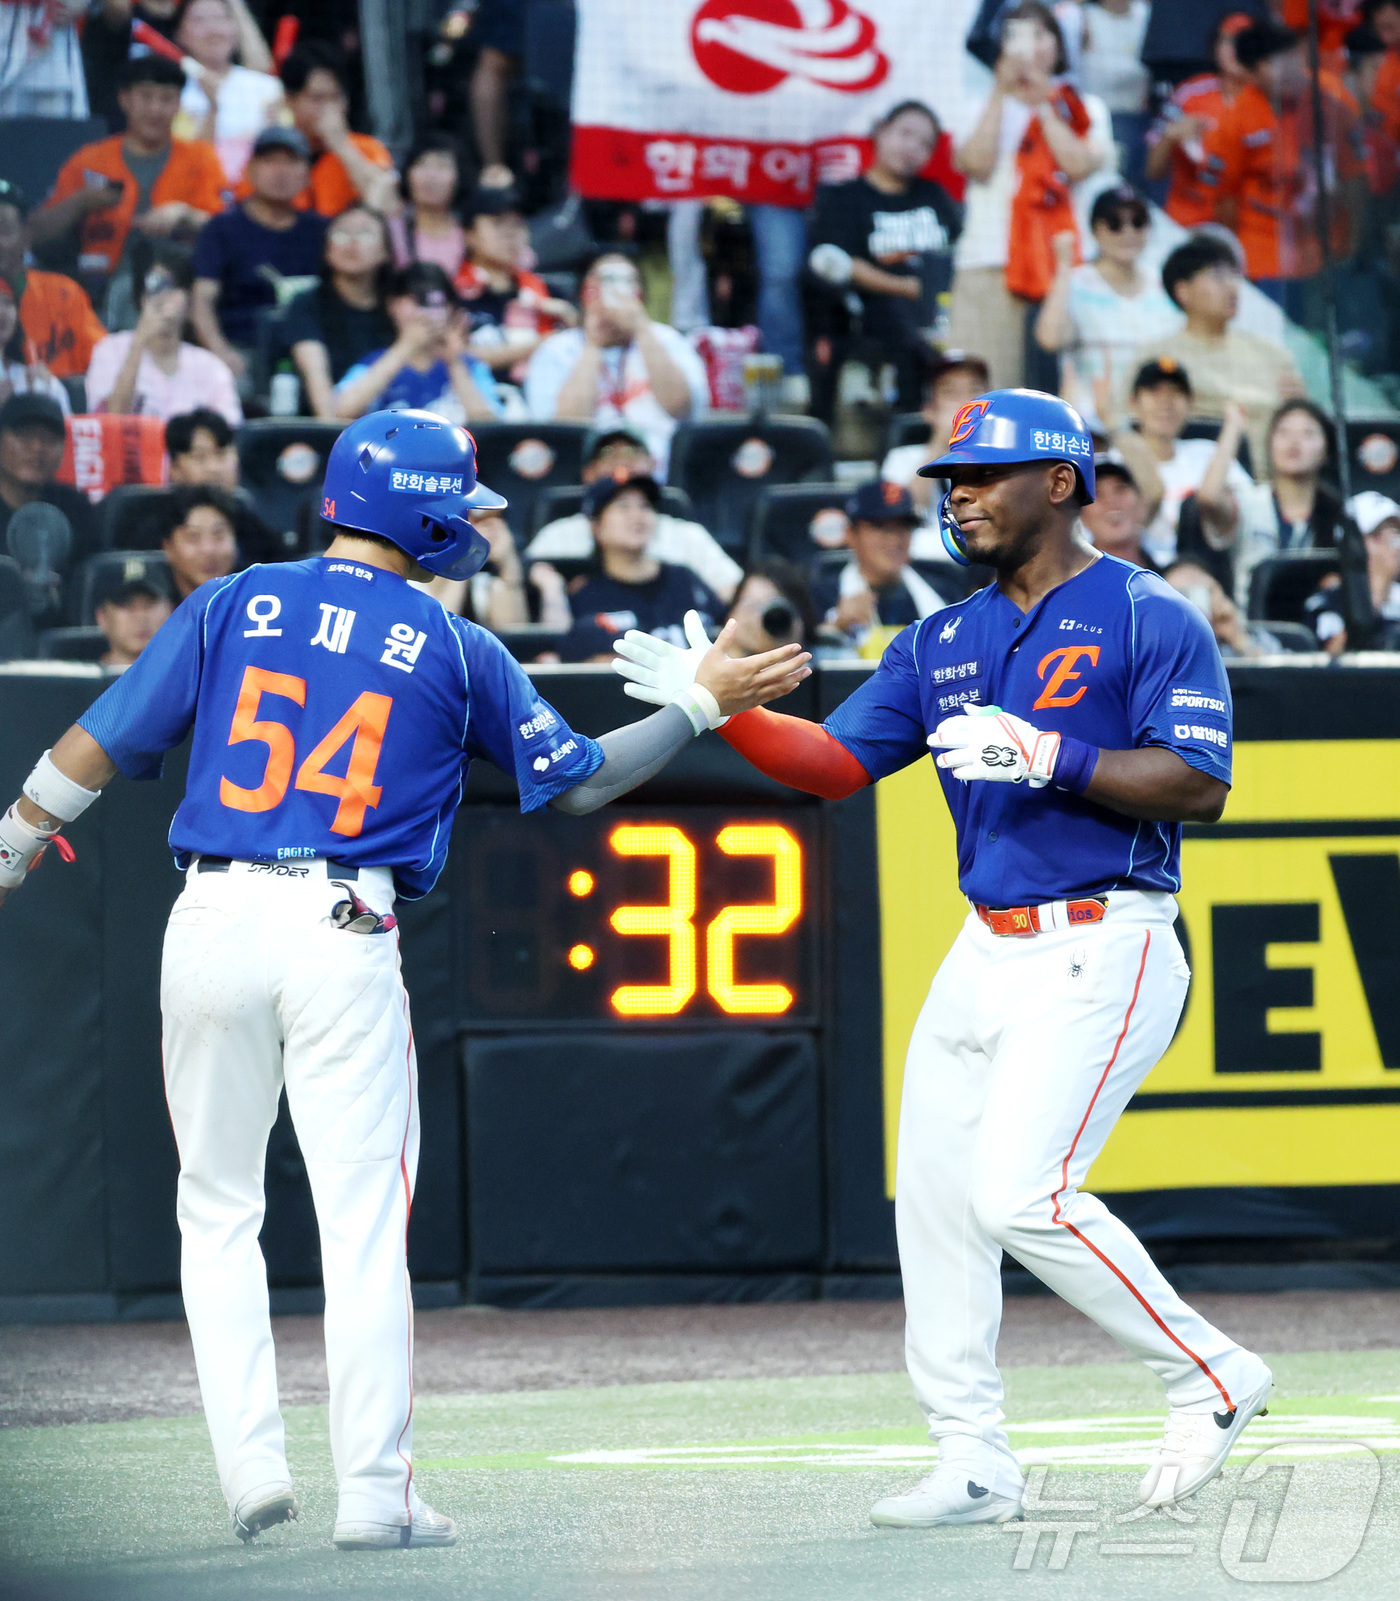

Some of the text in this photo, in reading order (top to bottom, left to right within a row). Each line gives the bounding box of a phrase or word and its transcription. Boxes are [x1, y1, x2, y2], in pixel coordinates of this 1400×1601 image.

[1033, 430, 1091, 457] 한화손보
[392, 471, 462, 494] 한화솔루션
[323, 497, 336, 519] 54
[327, 563, 374, 581] 모두의 안과
[1075, 623, 1104, 634] PLUS
[933, 661, 978, 683] 한화생명
[938, 688, 981, 711] 한화손보
[1171, 695, 1226, 713] SPORTSIX
[519, 709, 557, 740] 한화오션
[1190, 725, 1228, 748] 알바몬
[219, 665, 393, 838] 54
[277, 847, 316, 860] EAGLES
[247, 862, 310, 878] SPYDER
[1012, 913, 1028, 929] 30
[1067, 907, 1093, 921] ios
